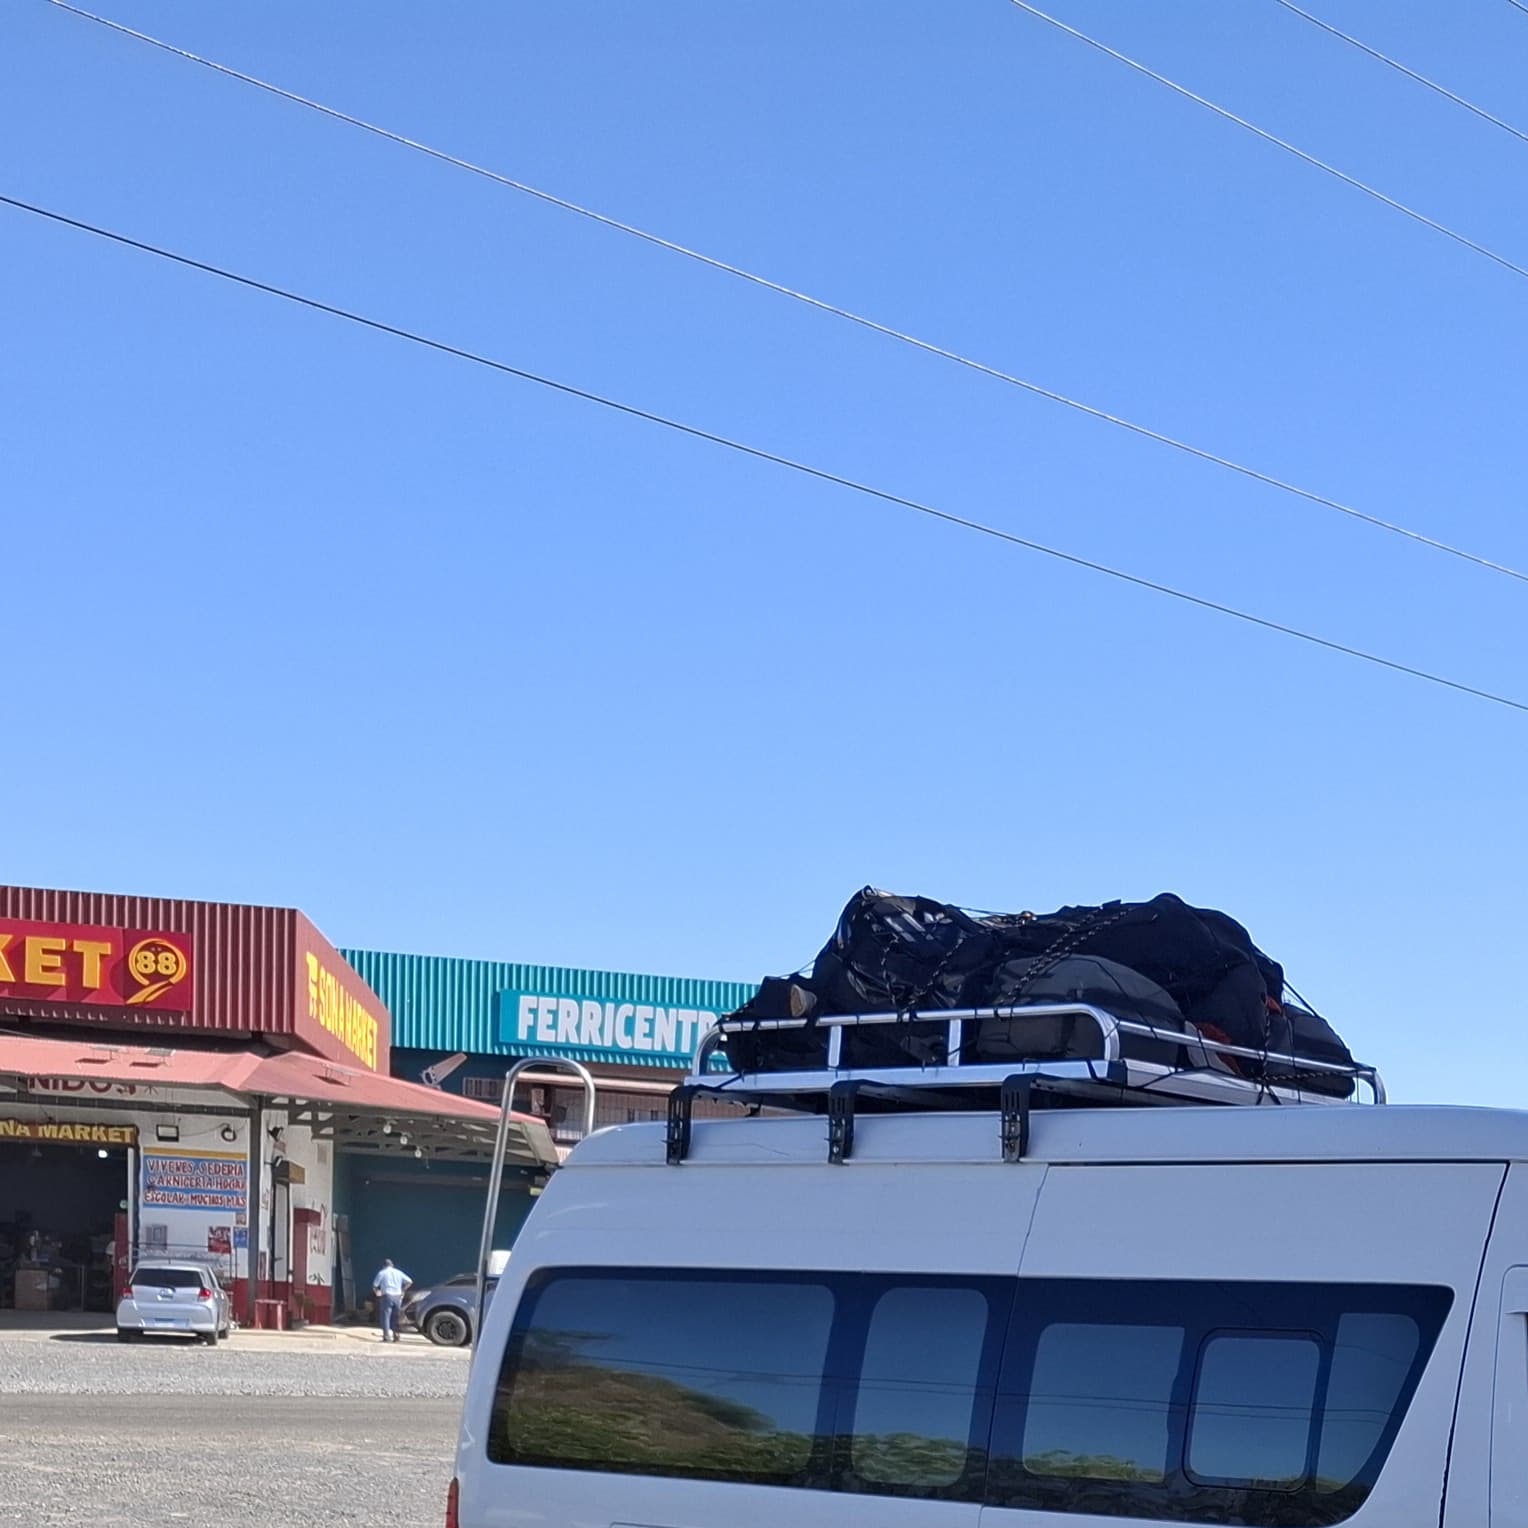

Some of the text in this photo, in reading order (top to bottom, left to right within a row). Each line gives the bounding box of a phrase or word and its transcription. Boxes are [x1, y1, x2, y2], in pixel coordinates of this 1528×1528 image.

[136, 950, 177, 976] 88
[319, 965, 378, 1072] SONA MARKET
[518, 995, 720, 1054] FERRICENTR
[38, 1123, 134, 1144] MARKET
